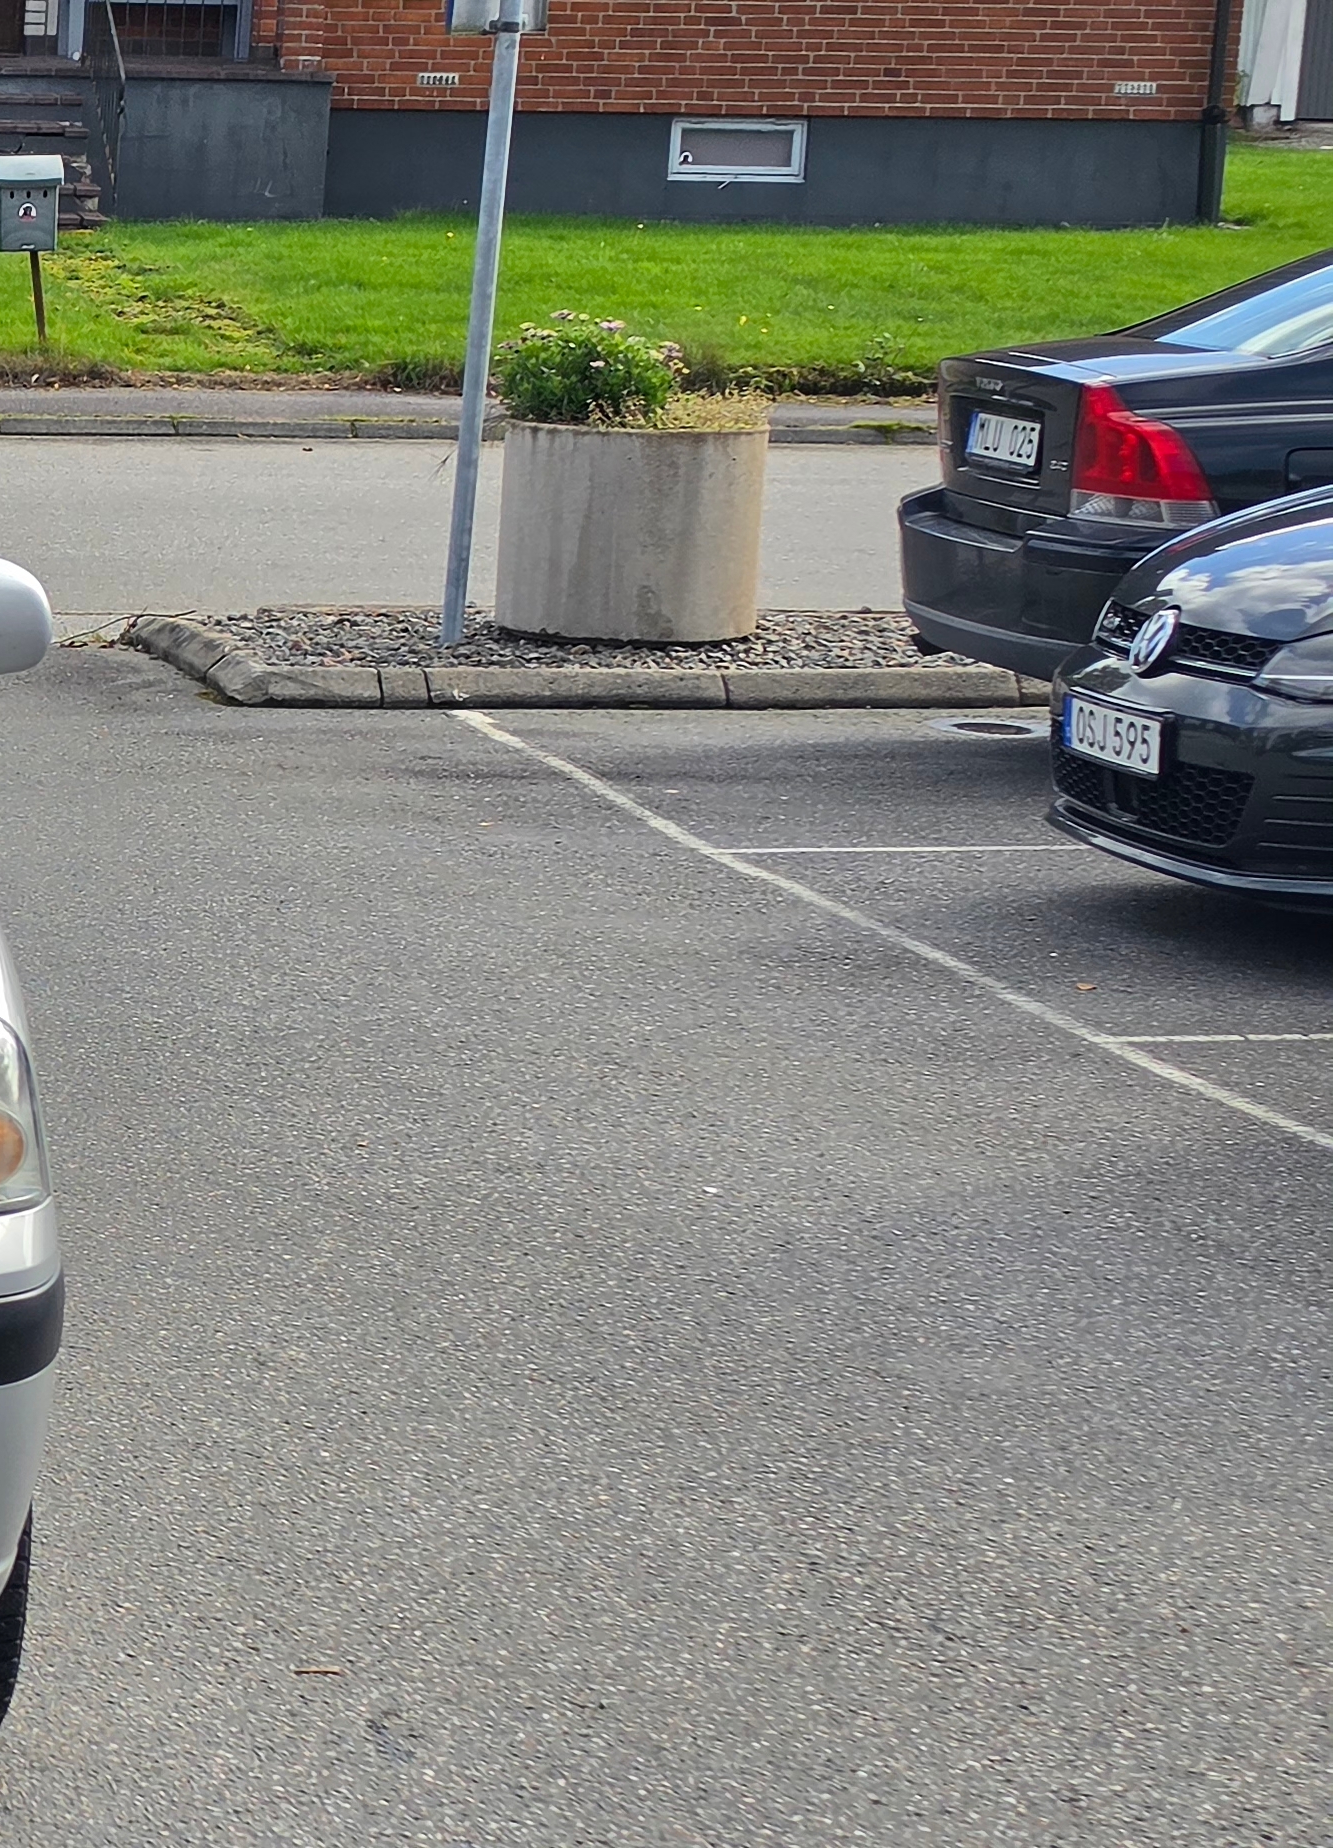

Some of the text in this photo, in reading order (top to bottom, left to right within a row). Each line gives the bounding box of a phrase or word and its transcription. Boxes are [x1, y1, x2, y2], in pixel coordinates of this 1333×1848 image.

[974, 417, 1036, 459] MLU 025
[1076, 706, 1151, 764] OSJ 595
